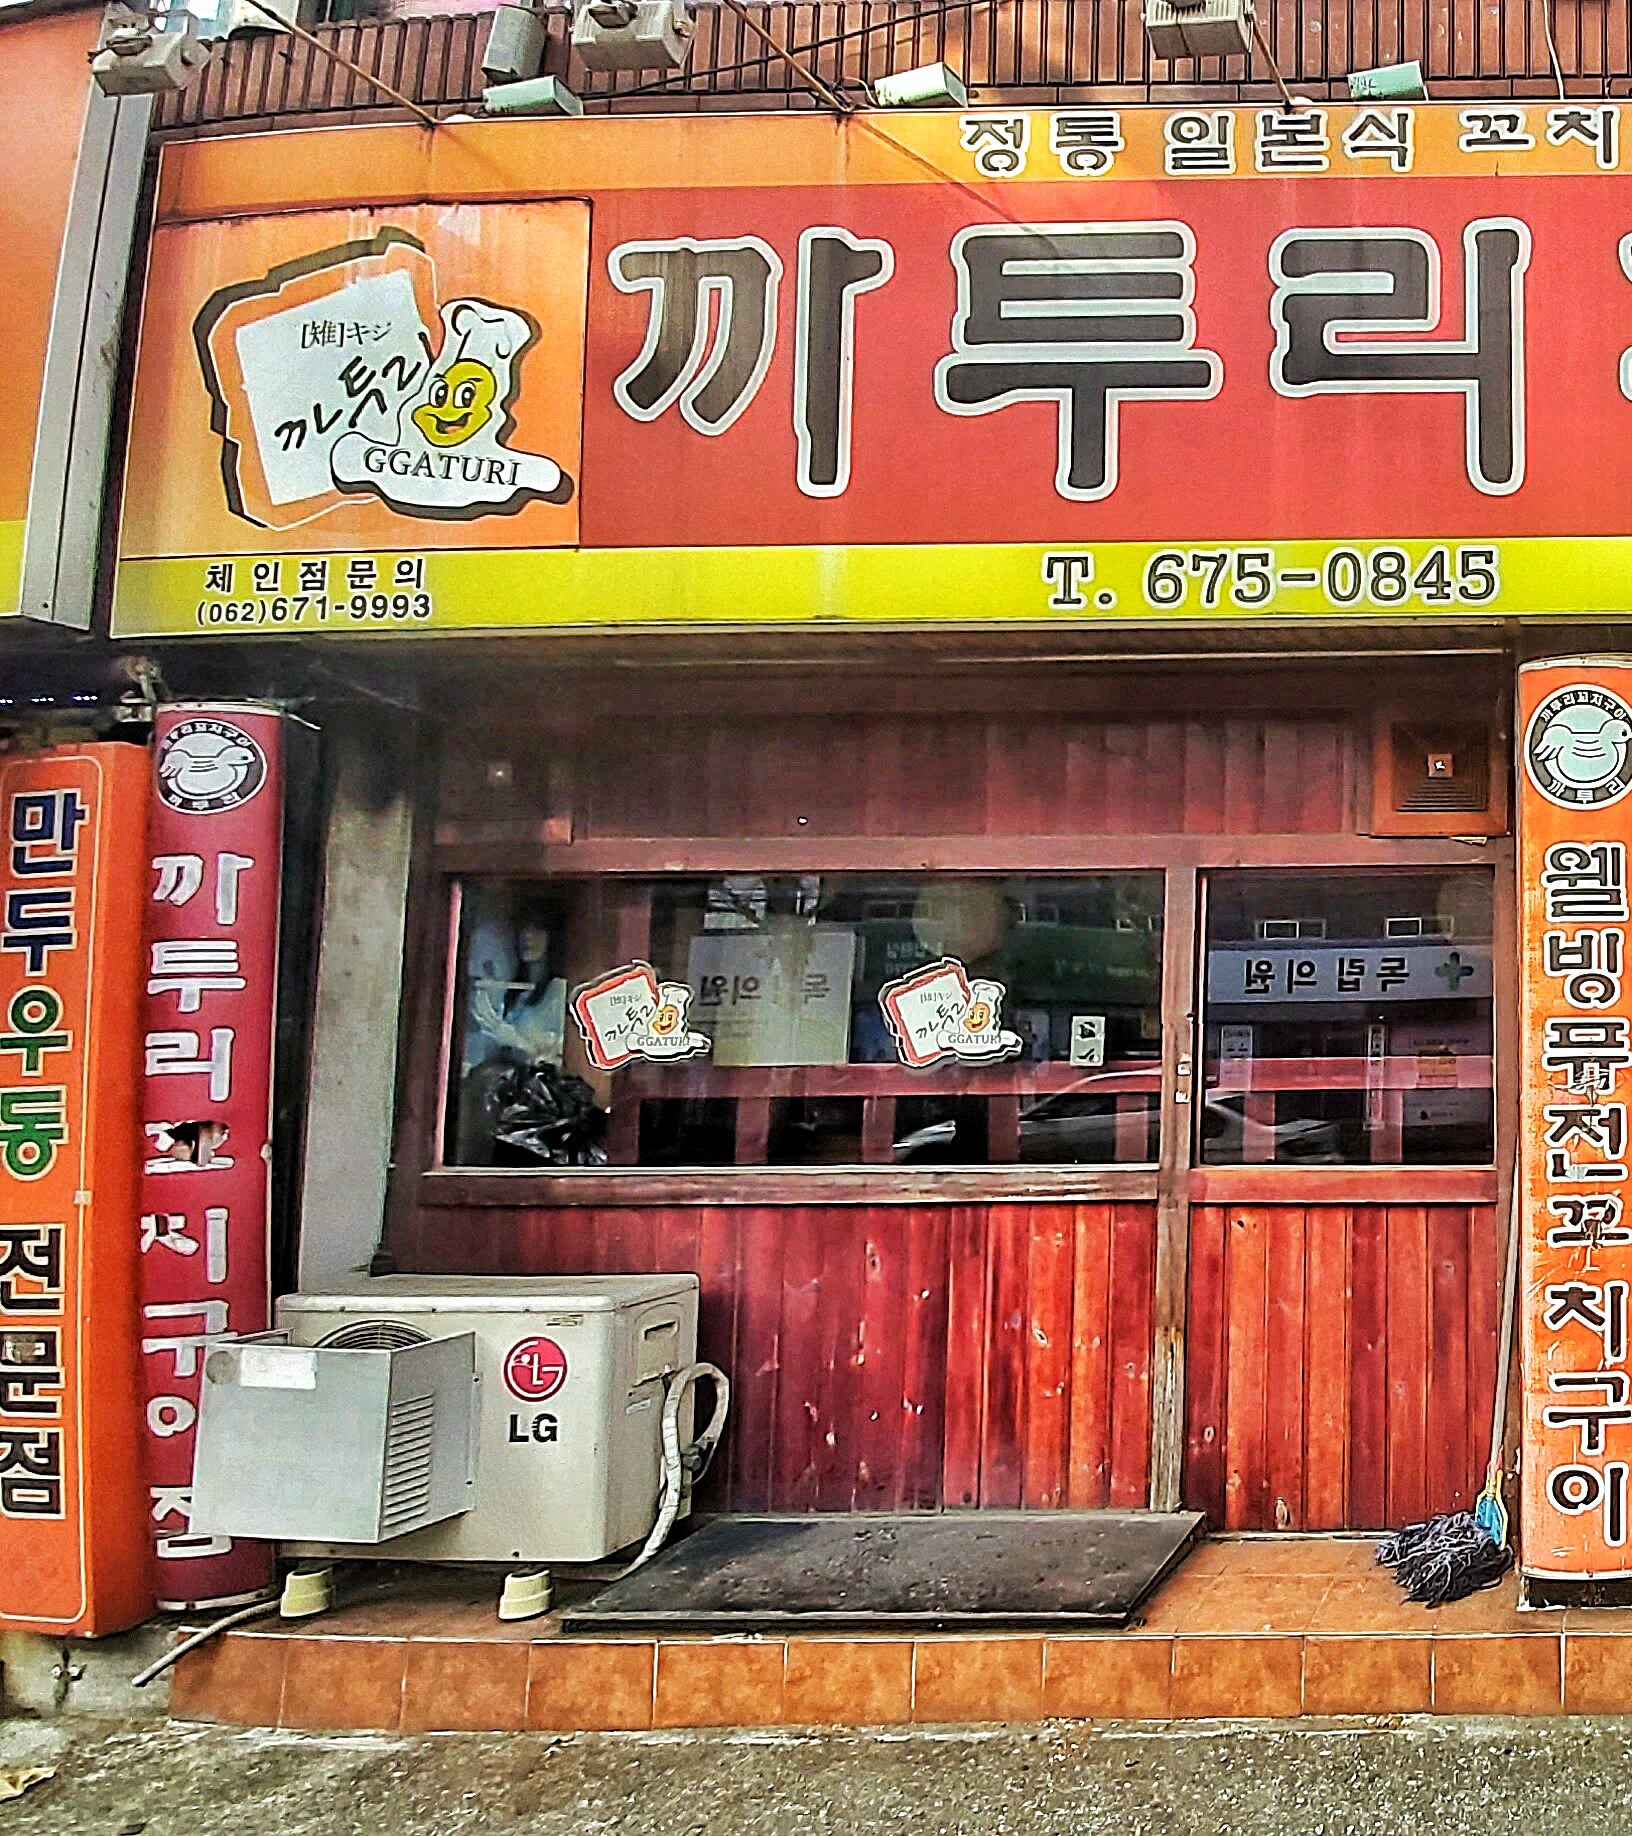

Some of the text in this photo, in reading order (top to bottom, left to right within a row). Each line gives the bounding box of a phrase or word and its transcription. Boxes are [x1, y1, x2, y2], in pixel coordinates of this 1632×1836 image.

[961, 111, 1124, 176] 정통
[1165, 110, 1414, 173] 일본식
[606, 216, 1532, 502] 까투리
[363, 446, 522, 487] GGATURI
[1045, 549, 1498, 608] T. 675-0845
[196, 593, 432, 626] (062)671-9993
[1547, 776, 1626, 804] 까투리
[509, 1413, 559, 1443] LG
